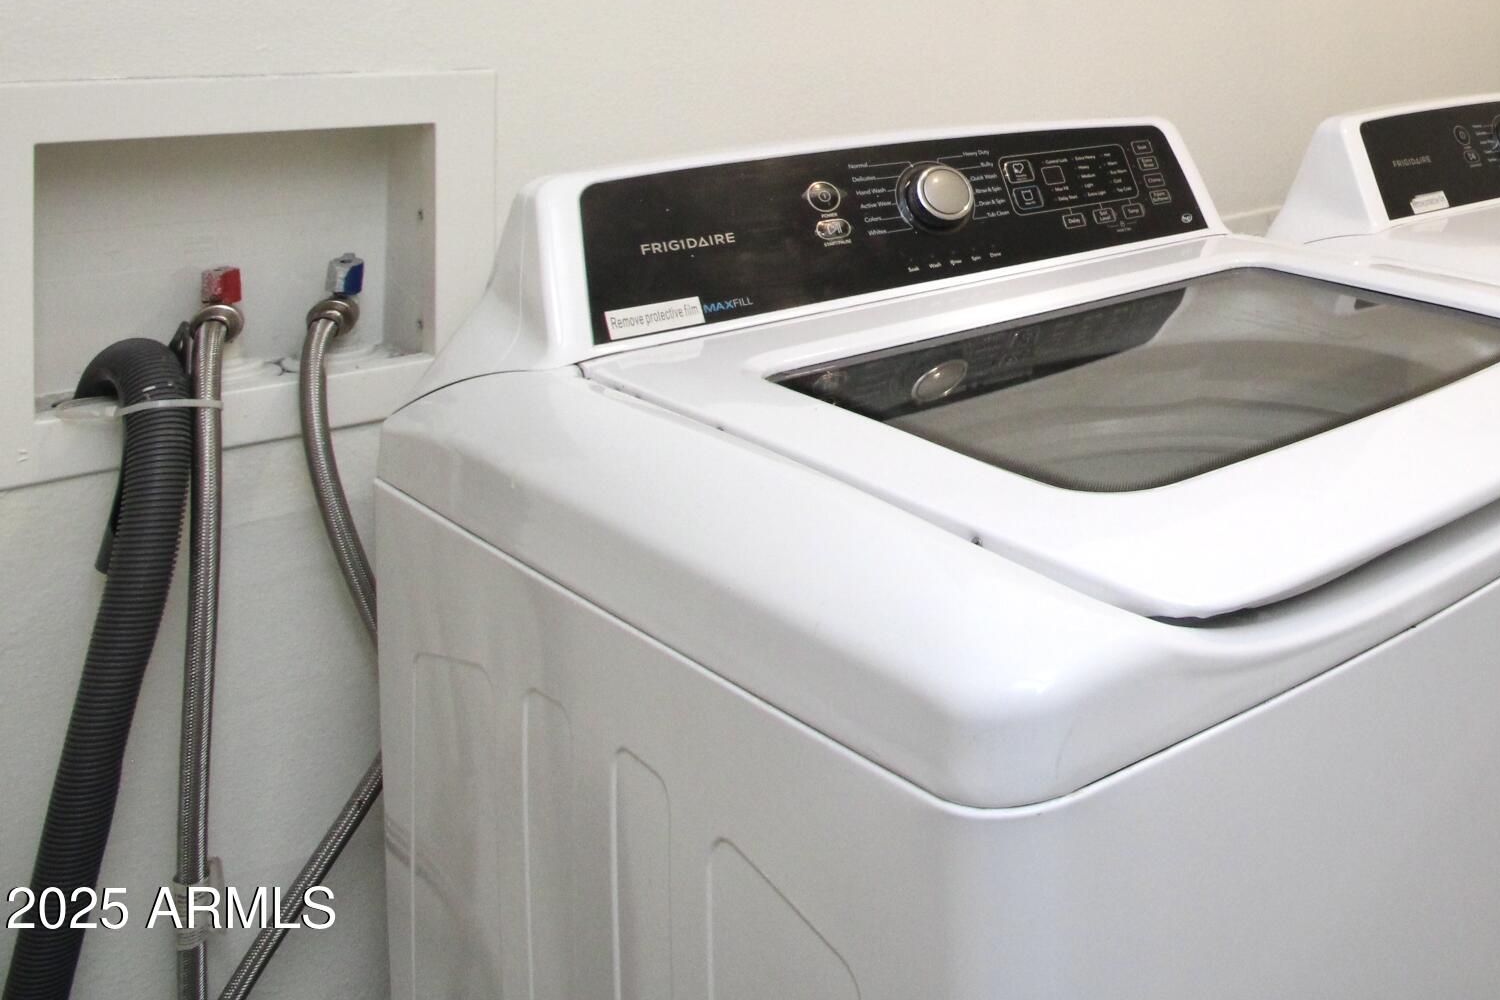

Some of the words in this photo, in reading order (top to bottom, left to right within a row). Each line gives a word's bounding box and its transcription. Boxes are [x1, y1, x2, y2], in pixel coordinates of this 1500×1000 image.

[847, 162, 869, 170] Normal
[1392, 155, 1432, 168] FRIGIDAIRE
[640, 232, 736, 256] FRIGIDAIRE
[610, 314, 645, 330] Remove
[645, 306, 684, 326] protective
[684, 303, 699, 316] film
